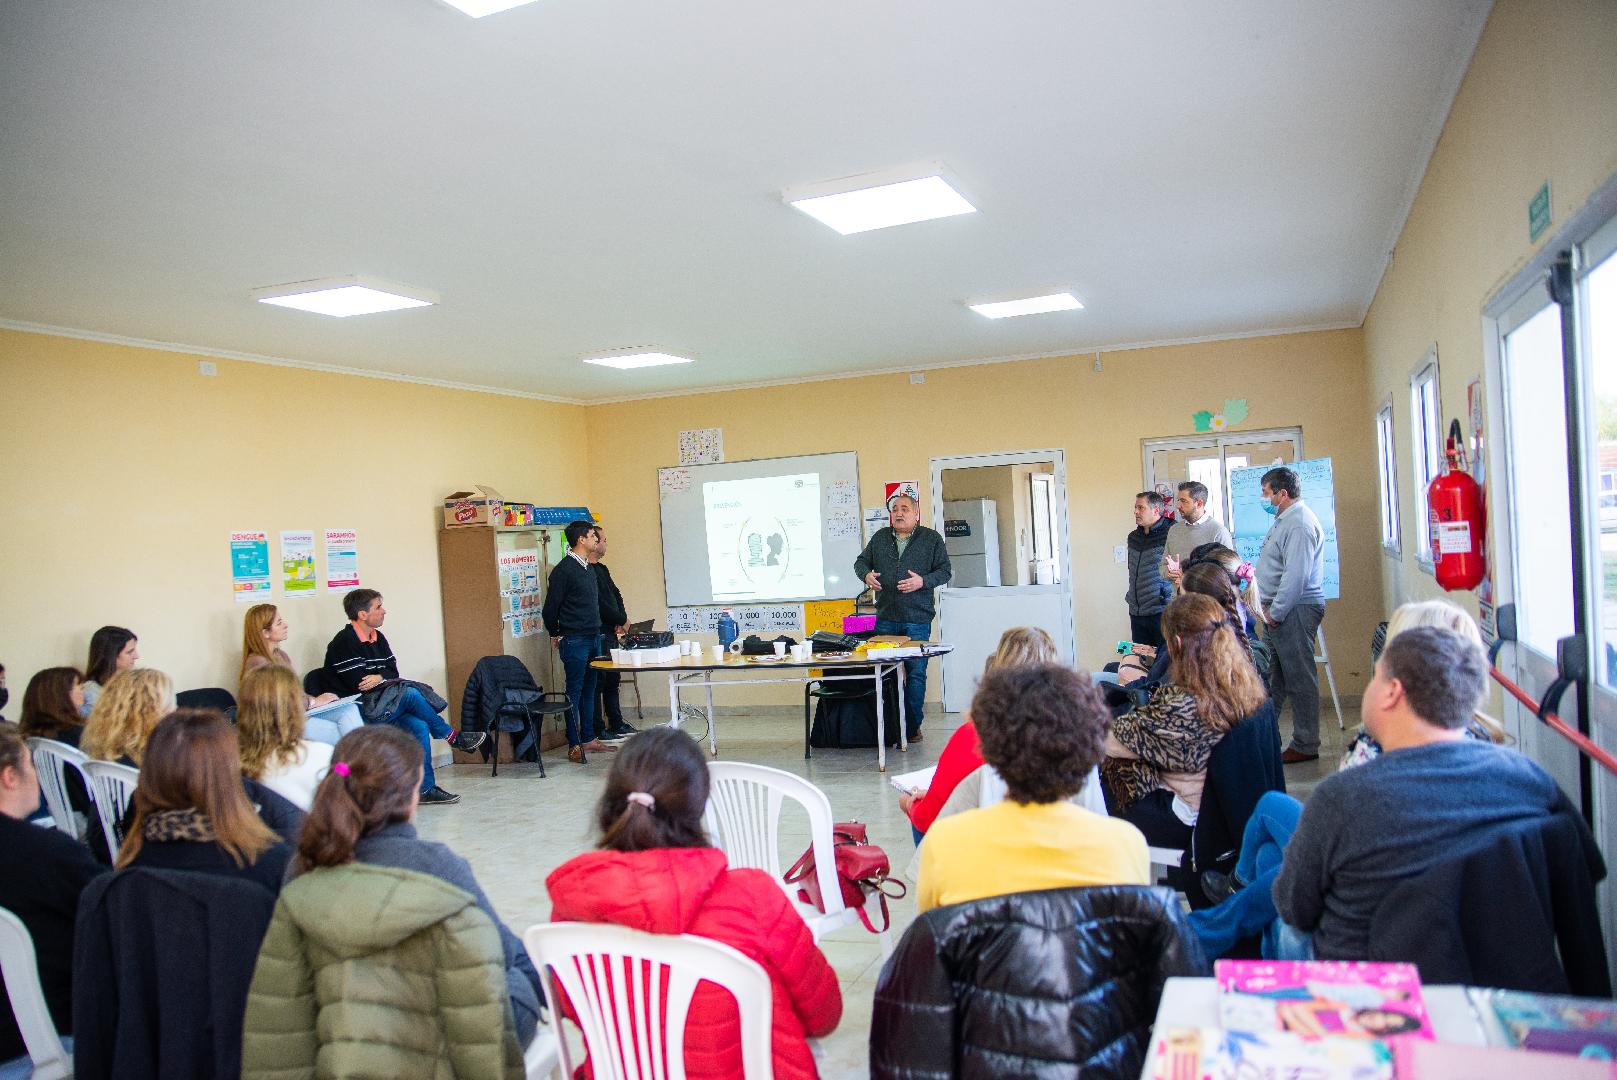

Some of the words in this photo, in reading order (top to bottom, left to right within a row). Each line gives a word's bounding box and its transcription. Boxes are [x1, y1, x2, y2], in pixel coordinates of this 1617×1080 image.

[232, 533, 257, 541] DENGUE
[500, 557, 511, 565] LOS
[511, 554, 536, 564] NÚMEROS
[771, 611, 797, 619] 10.000
